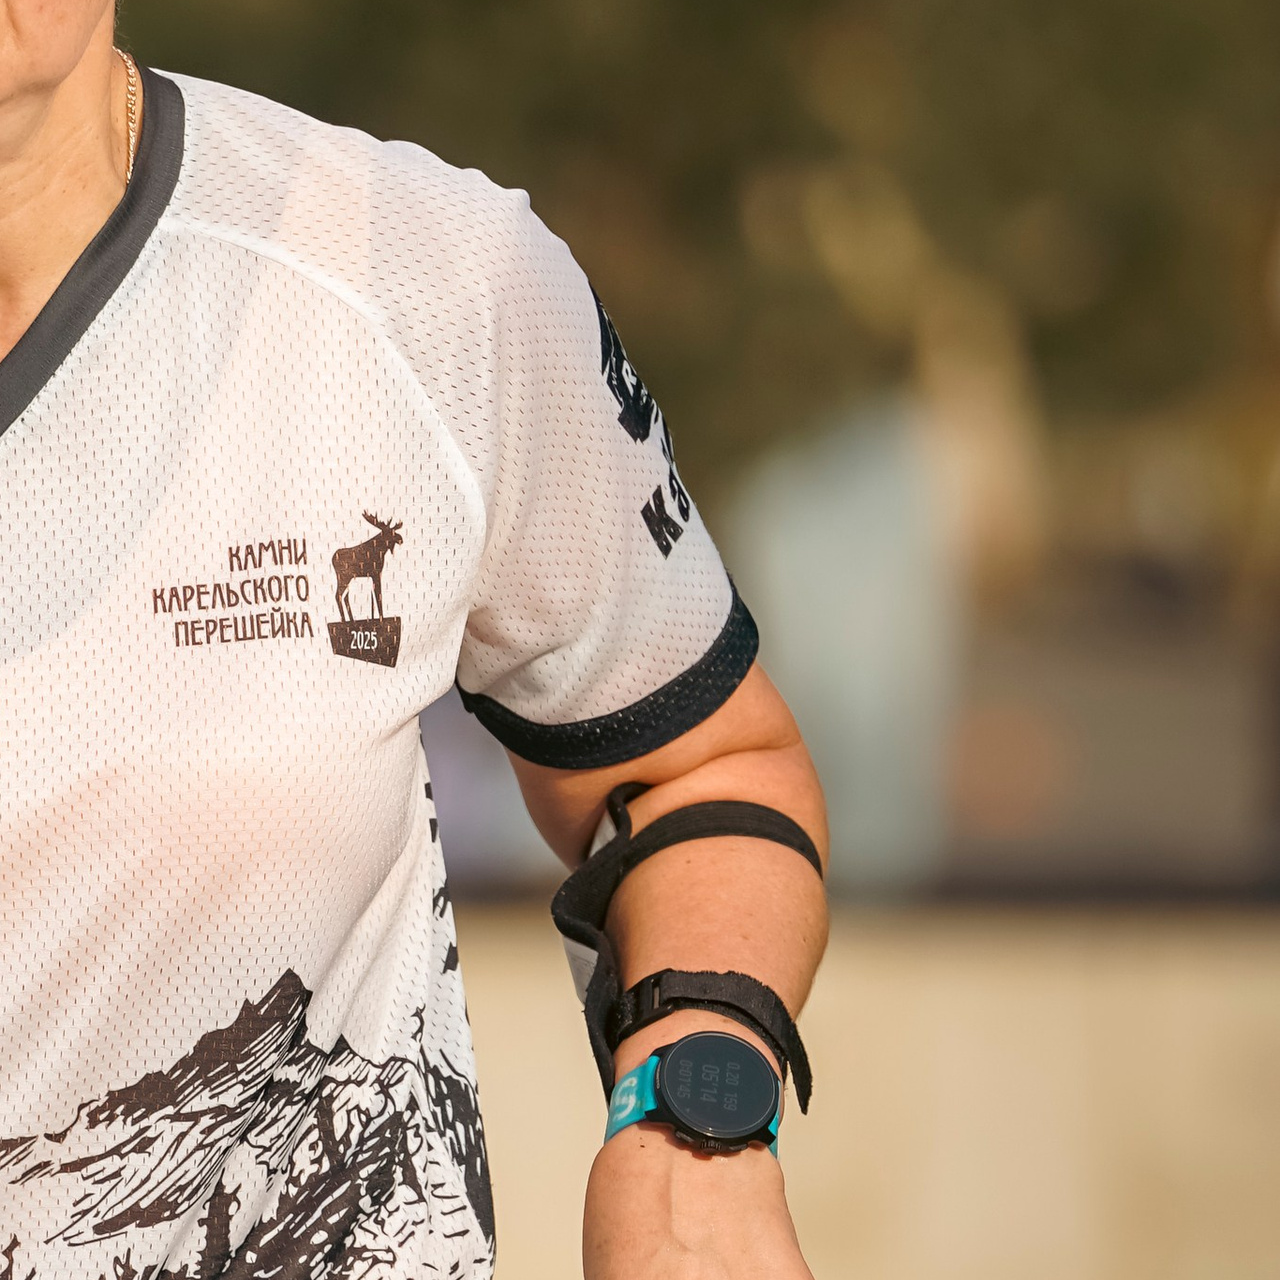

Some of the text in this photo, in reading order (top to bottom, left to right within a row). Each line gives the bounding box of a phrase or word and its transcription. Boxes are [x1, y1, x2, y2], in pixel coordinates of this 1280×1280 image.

[228, 538, 308, 571] КАМНИ
[152, 574, 310, 614] КАРЕЛЬСКОГО
[174, 607, 314, 647] ПЕРЕШЕЙКА
[350, 630, 378, 650] 2025
